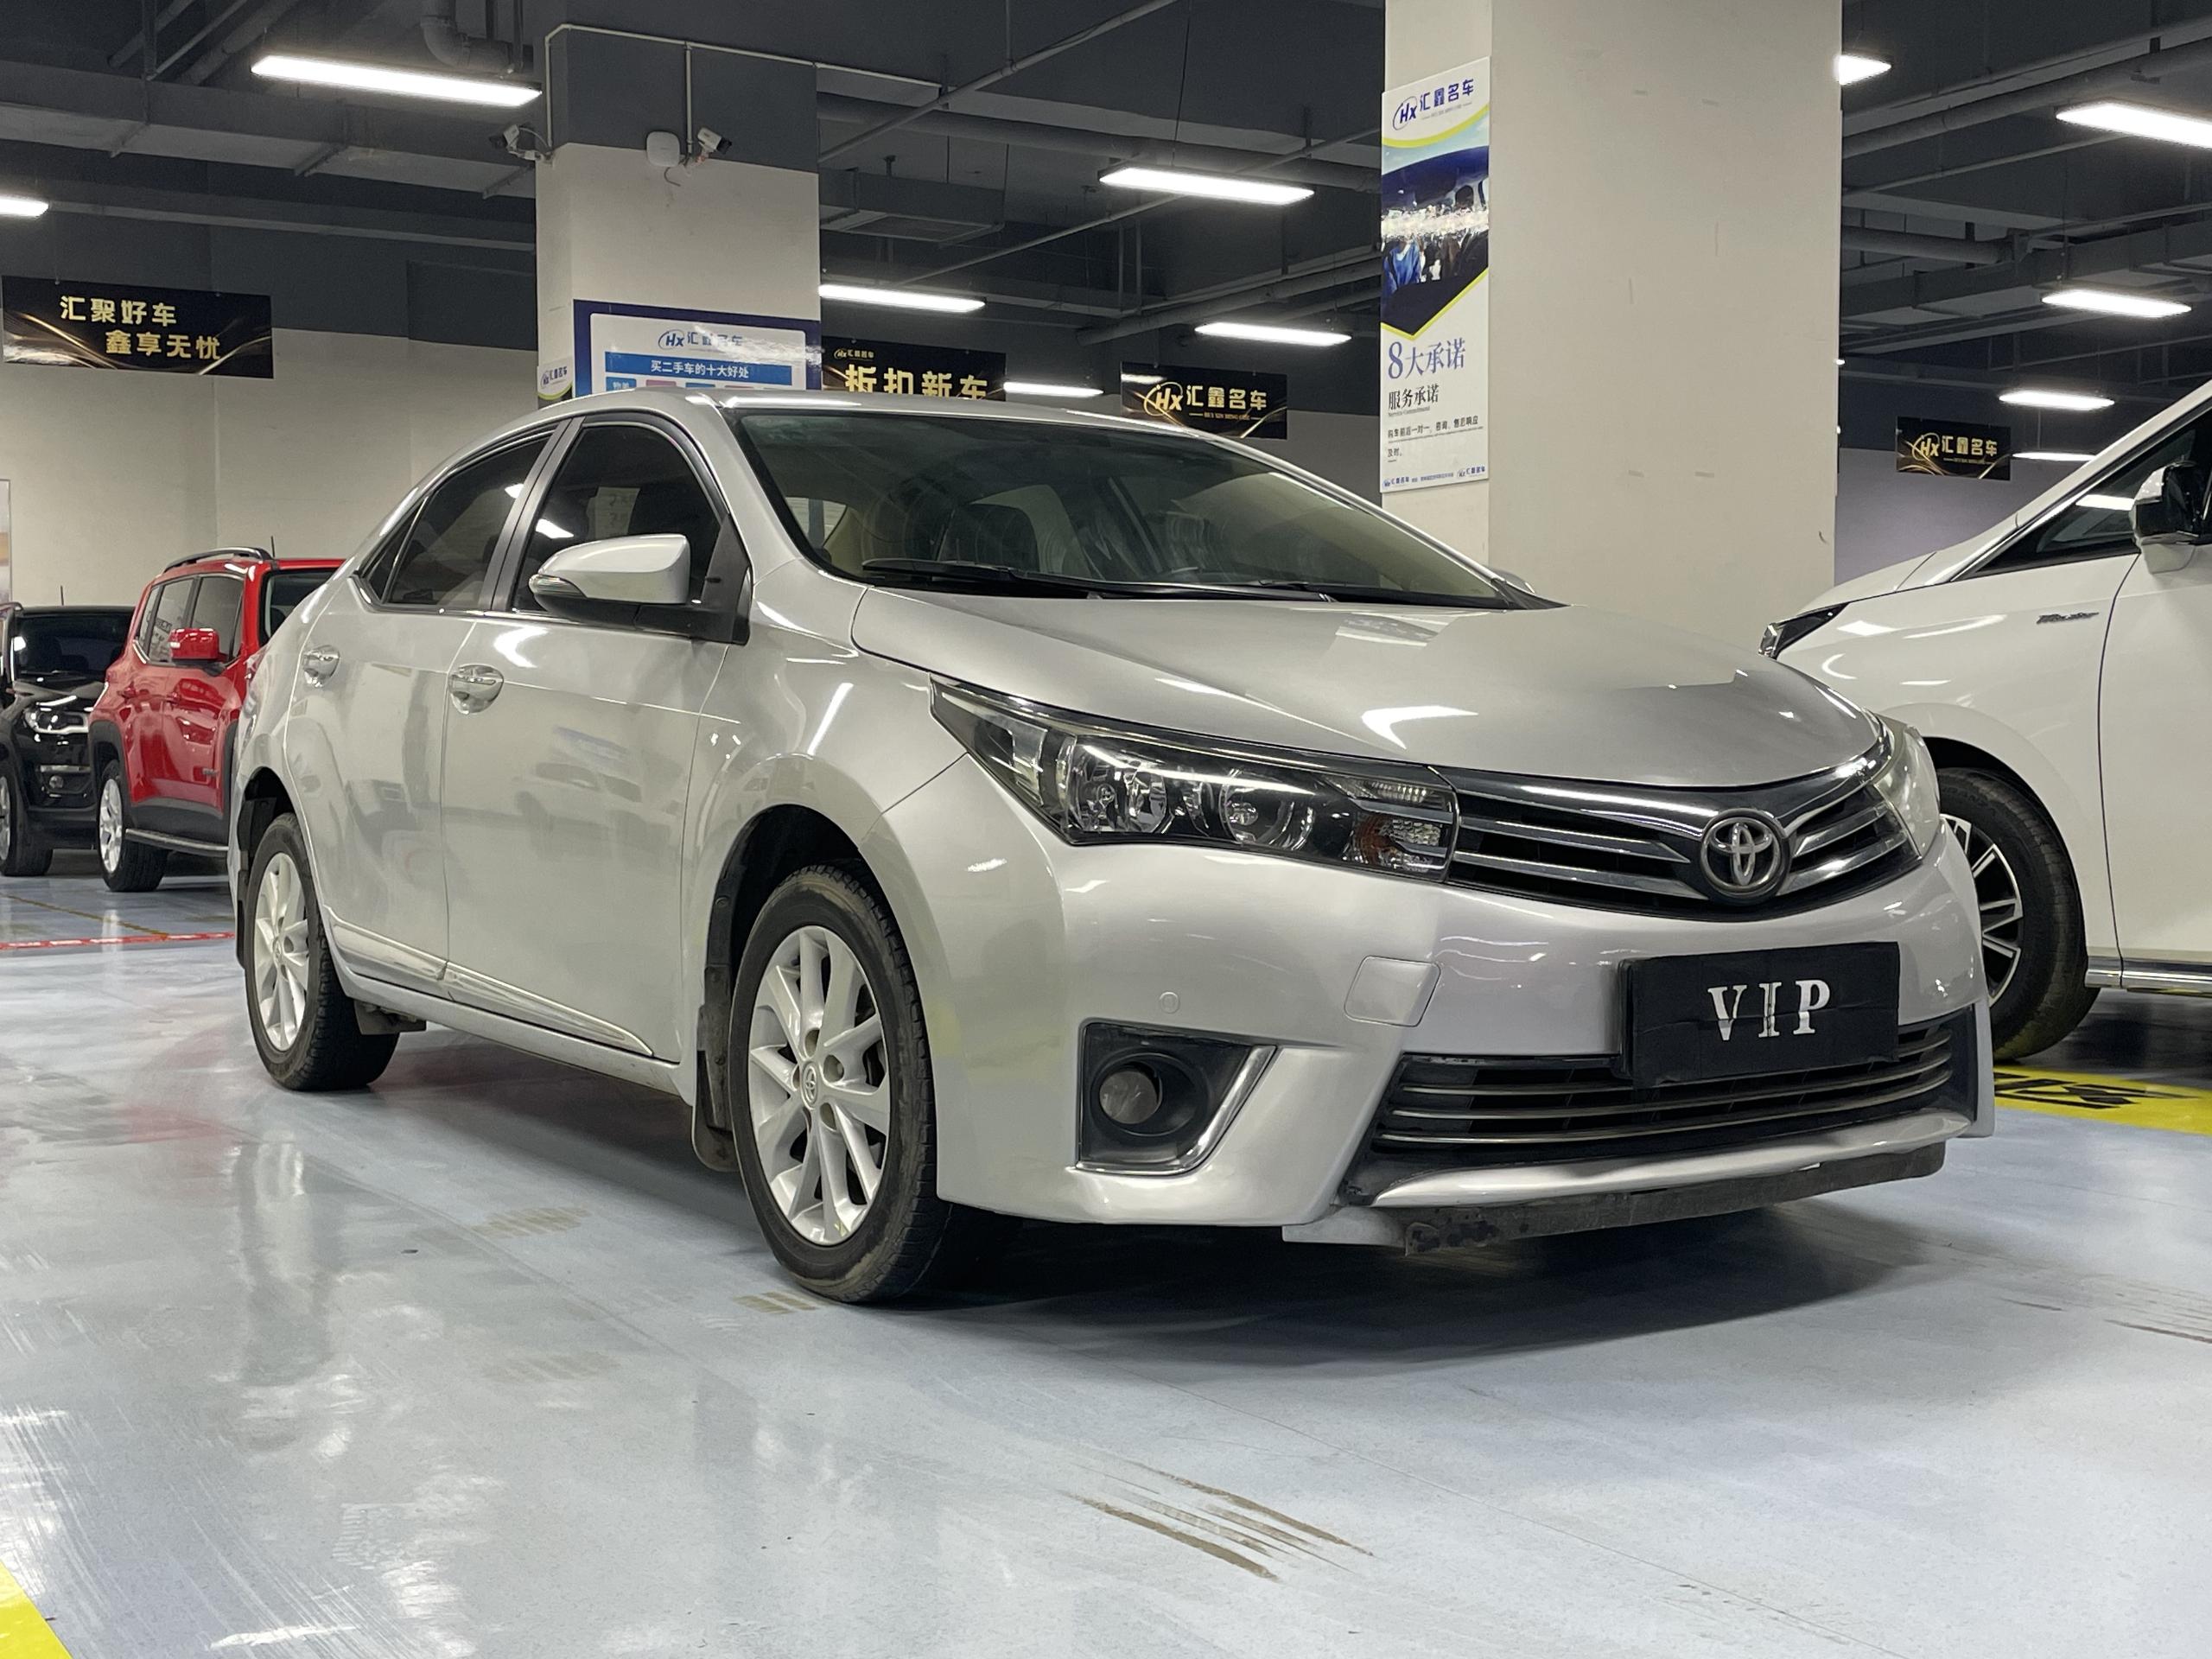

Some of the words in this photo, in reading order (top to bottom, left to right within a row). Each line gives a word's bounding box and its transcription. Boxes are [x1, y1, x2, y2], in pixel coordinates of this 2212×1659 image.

[1419, 79, 1474, 112] 汇鑫名车
[60, 296, 177, 327] 汇聚好车
[105, 329, 220, 360] 鑫享无忧
[1388, 337, 1466, 379] 8大承诺
[651, 359, 749, 378] 买二手车的十大好处
[845, 364, 988, 400] 折扣新车
[1186, 385, 1267, 410] 汇鑫名车
[1389, 384, 1440, 410] 服务承诺
[1942, 435, 1998, 457] 汇鑫名车
[1707, 979, 1831, 1041] VIP
